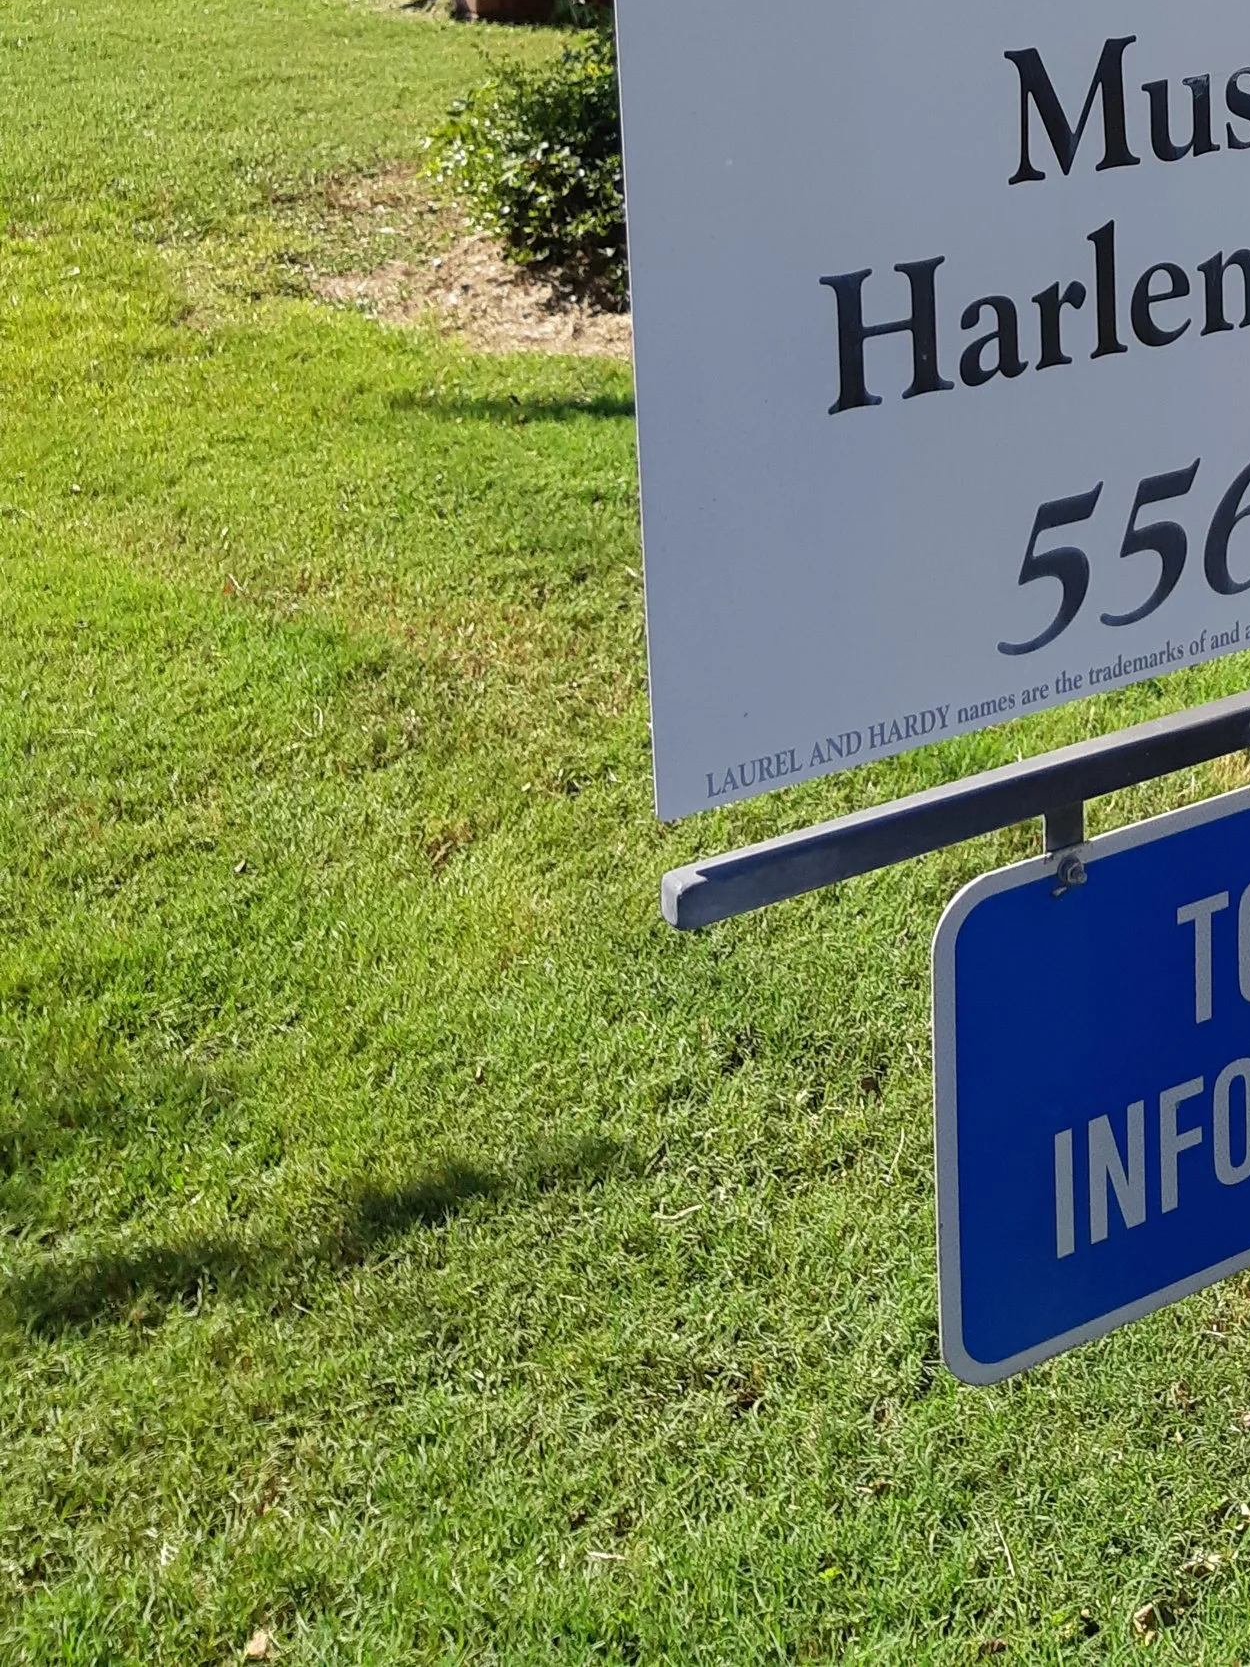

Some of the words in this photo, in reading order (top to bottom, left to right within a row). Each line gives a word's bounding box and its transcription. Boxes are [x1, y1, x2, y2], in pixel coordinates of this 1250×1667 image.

[706, 748, 803, 798] LAUREL
[809, 731, 861, 767] AND
[867, 703, 950, 749] HARDY
[956, 691, 1016, 723] names
[1021, 680, 1049, 700] are
[1054, 670, 1083, 695] the
[1088, 640, 1184, 685] trademarks
[1189, 635, 1207, 658] of
[1210, 620, 1240, 650] and
